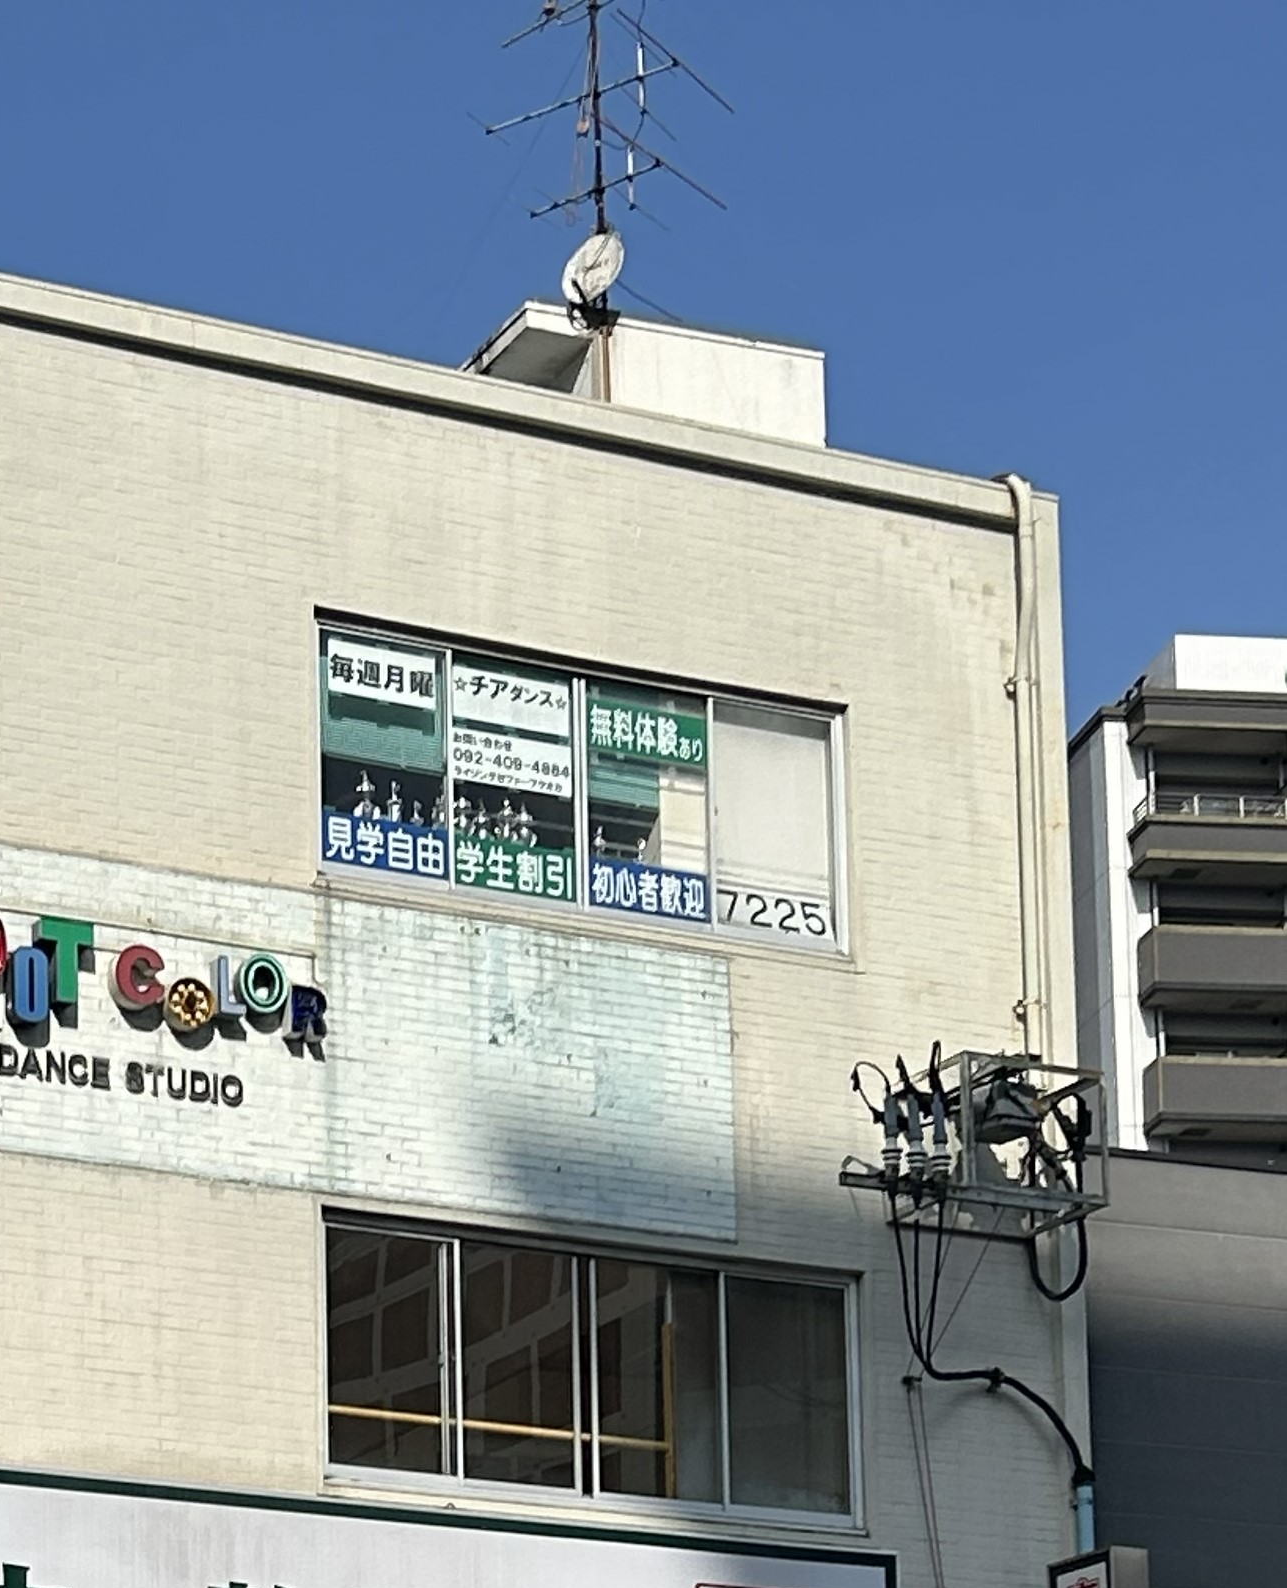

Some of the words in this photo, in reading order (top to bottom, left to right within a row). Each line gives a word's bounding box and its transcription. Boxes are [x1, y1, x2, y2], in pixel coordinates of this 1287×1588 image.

[329, 653, 434, 697] 毎週月曜
[589, 704, 703, 762] 無料体験あり
[325, 816, 445, 877] 見学自由
[455, 842, 573, 898] 学生割引
[591, 863, 705, 919] 初心者歓迎
[716, 889, 826, 936] 7225
[126, 1062, 244, 1107] STUDIO
